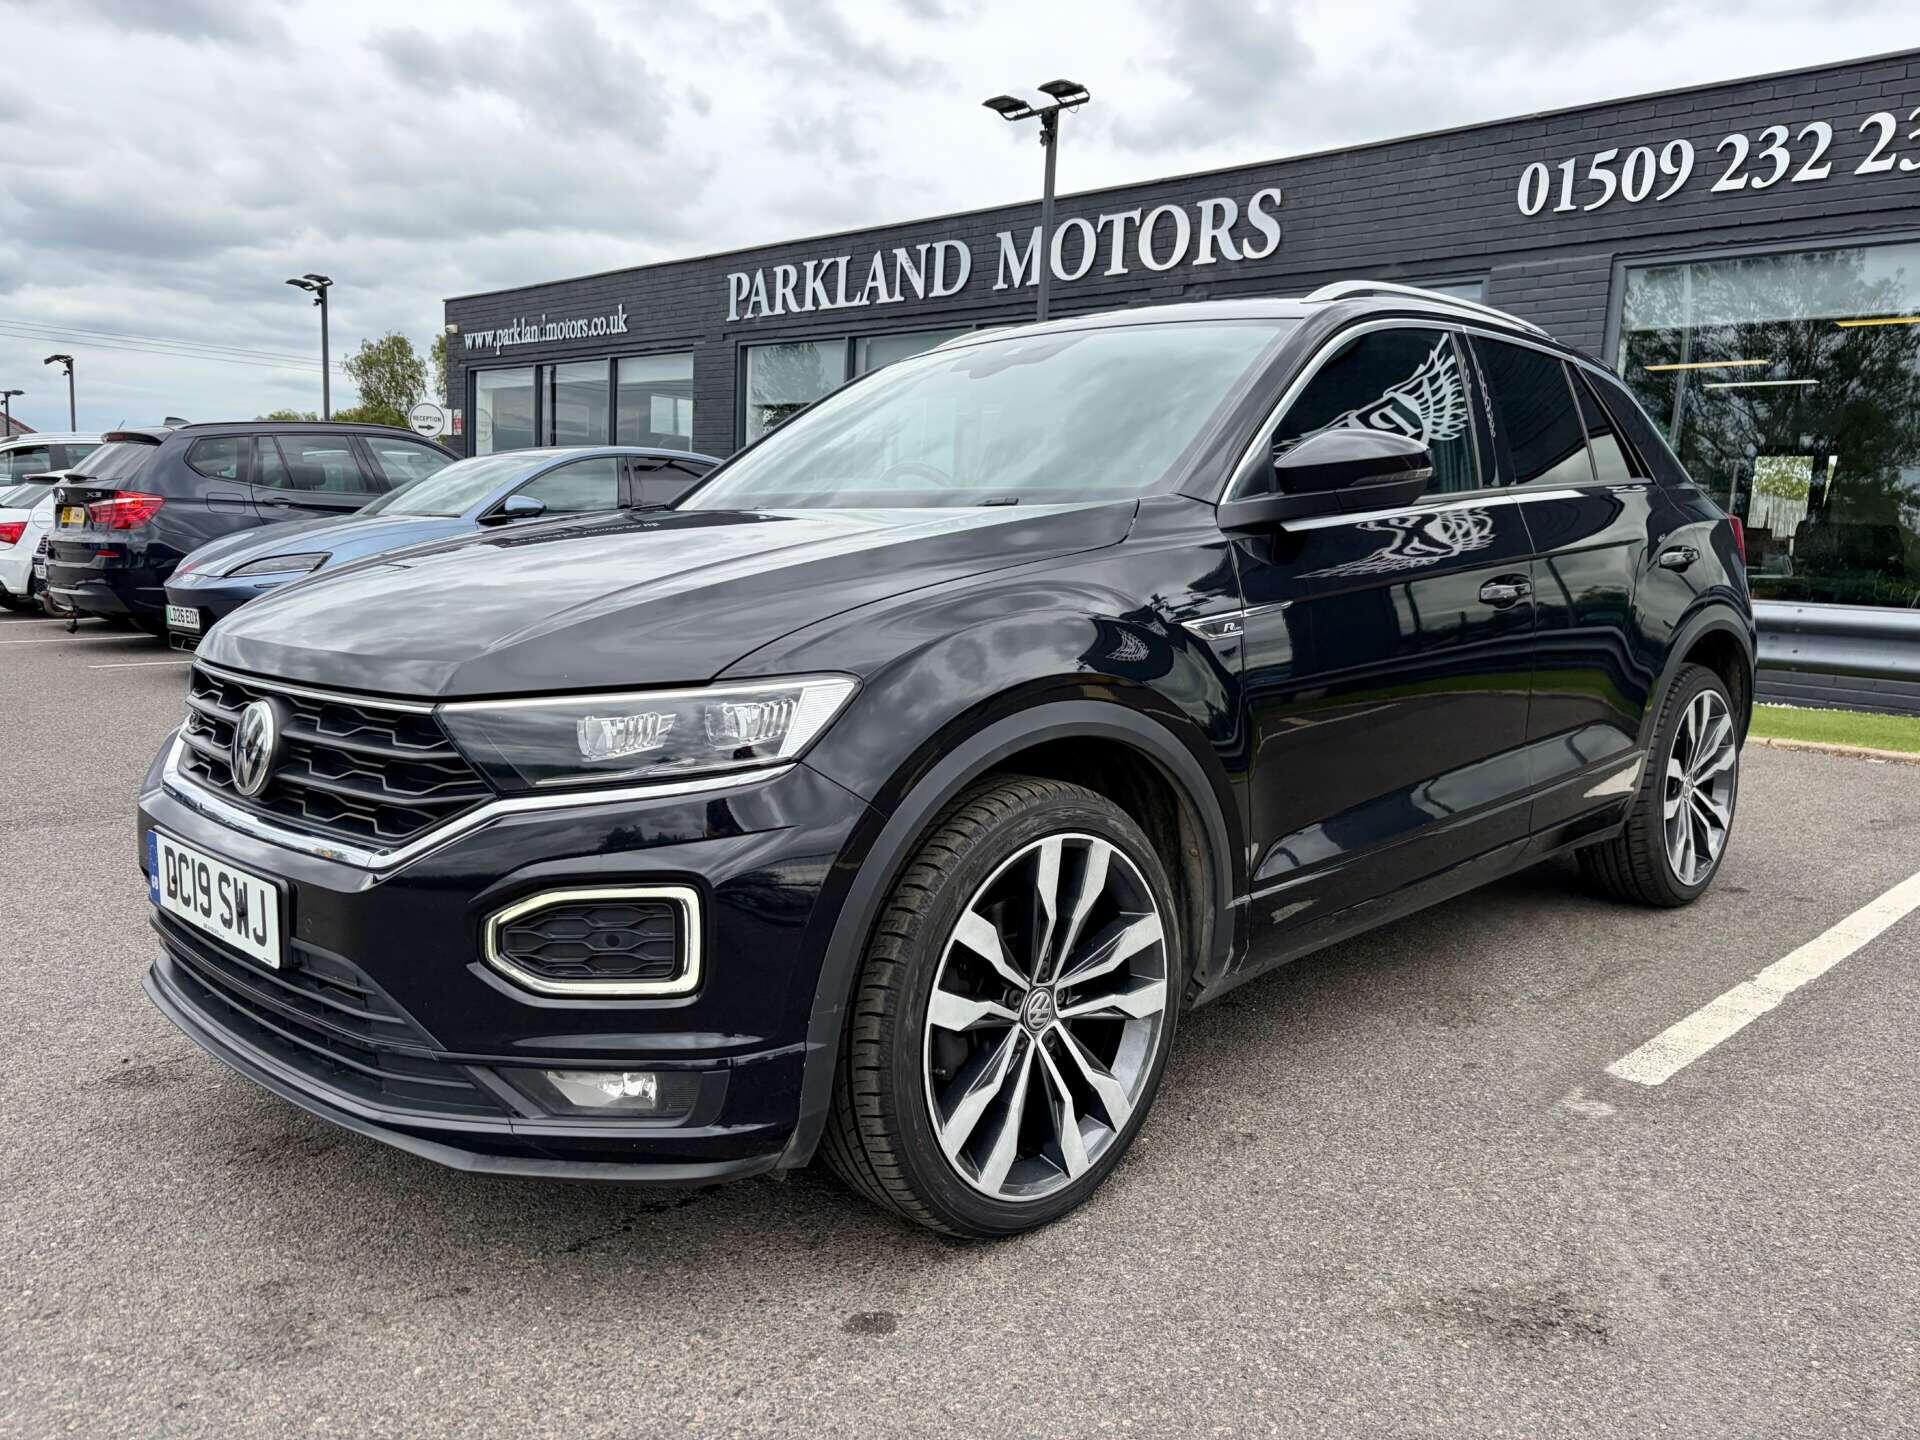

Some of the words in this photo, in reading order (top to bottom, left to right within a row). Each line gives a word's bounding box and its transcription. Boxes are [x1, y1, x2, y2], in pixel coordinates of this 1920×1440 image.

[1517, 138, 1696, 217] 01509
[1710, 120, 1834, 193] 232
[725, 238, 973, 322] PARKLAND
[992, 187, 1283, 291] MOTORS
[464, 303, 628, 355] www.parklandmotors.co.uk
[412, 415, 441, 423] RECEPTION
[163, 844, 213, 919] DC19
[217, 871, 268, 948] SWJ
